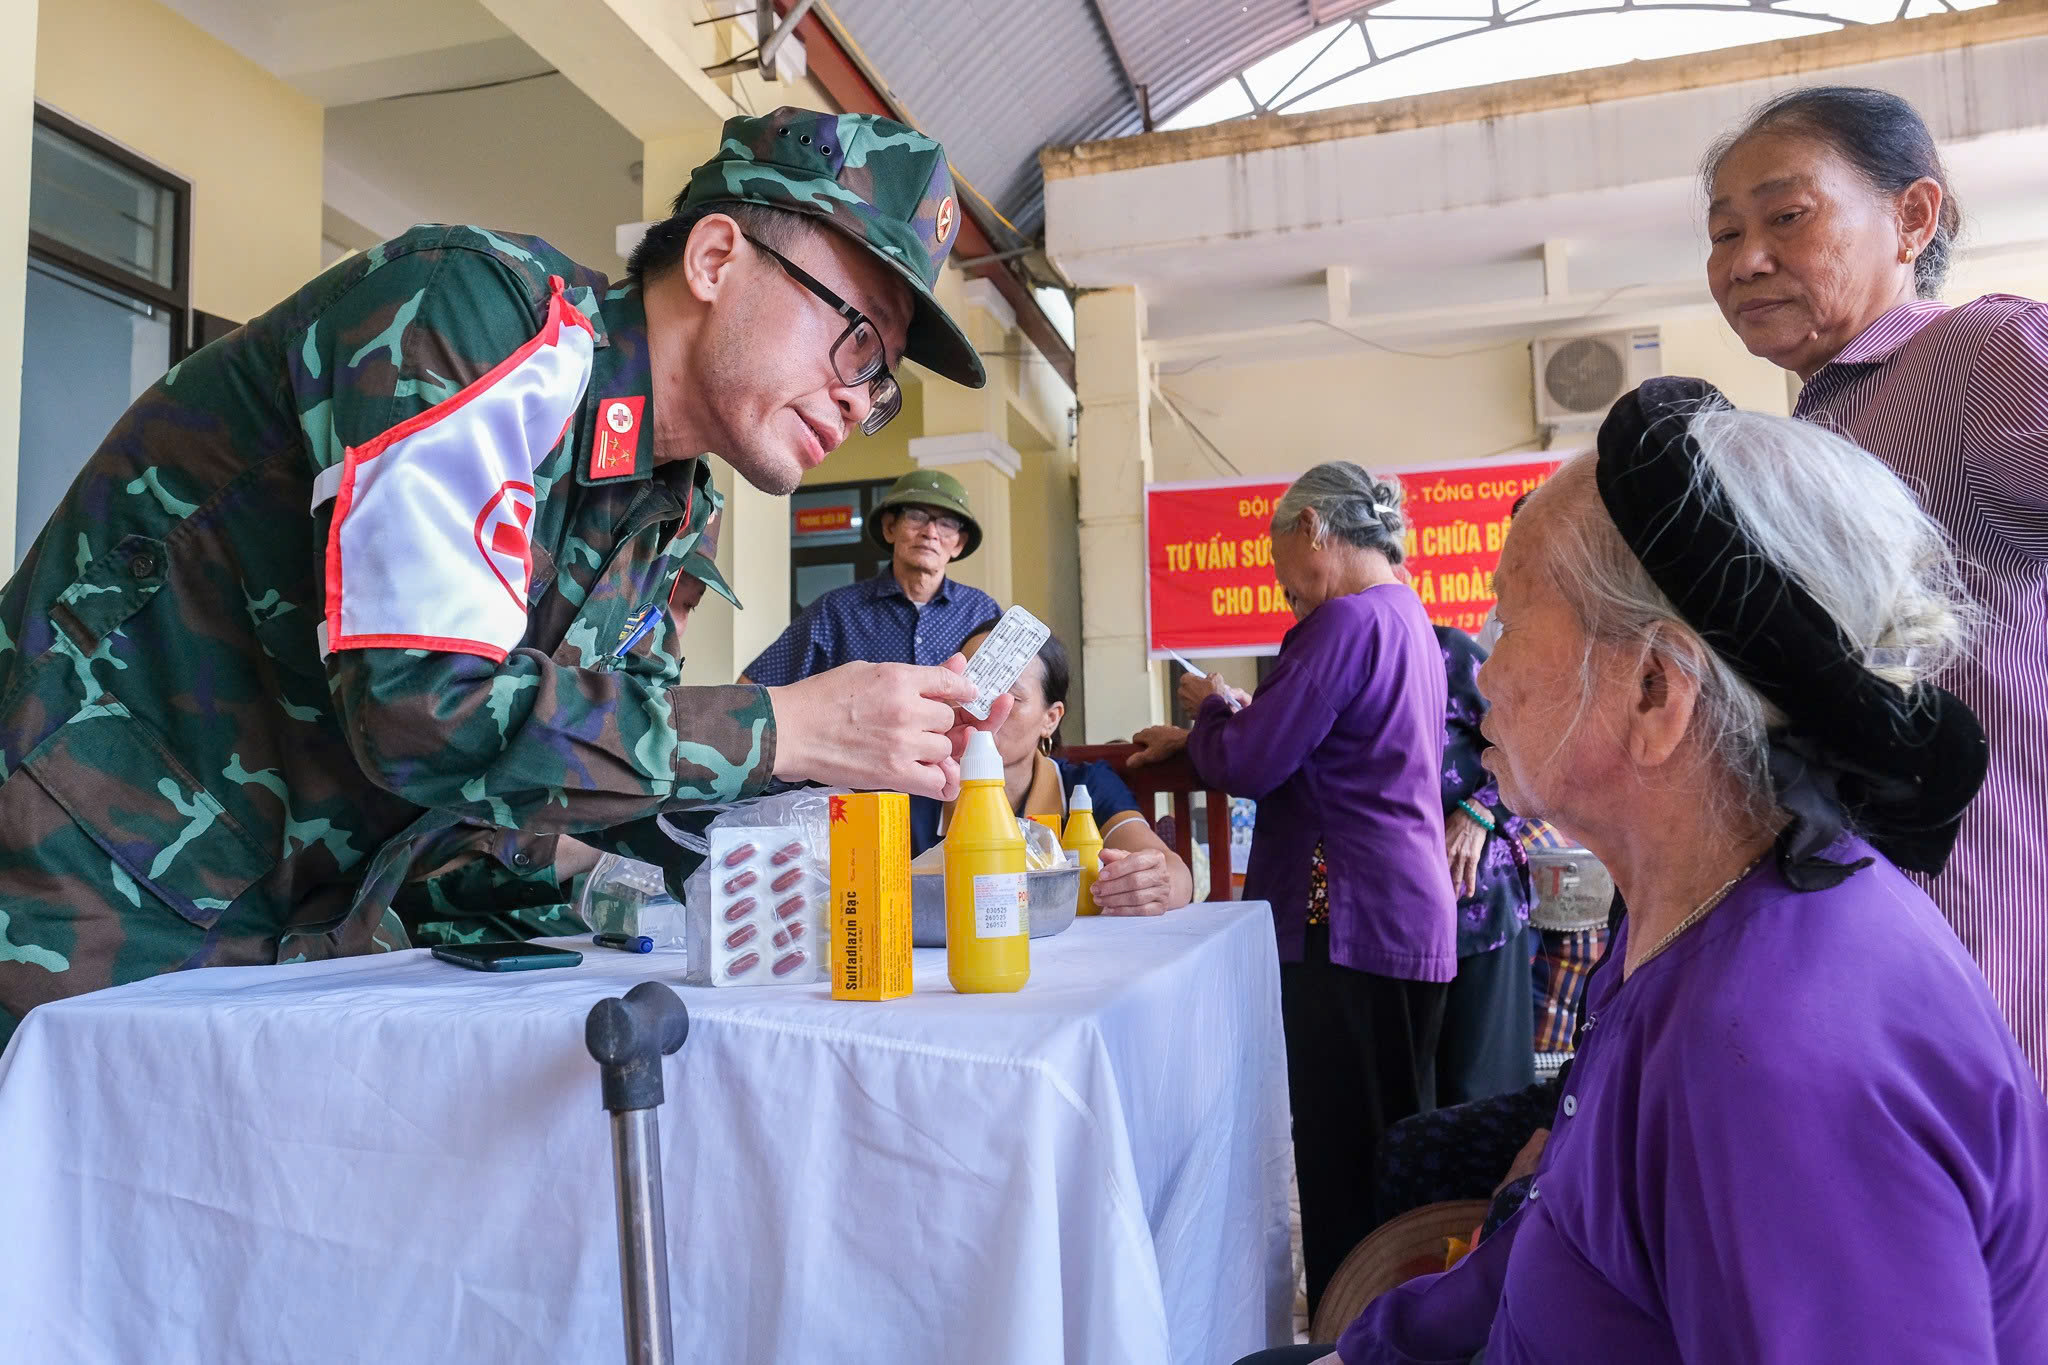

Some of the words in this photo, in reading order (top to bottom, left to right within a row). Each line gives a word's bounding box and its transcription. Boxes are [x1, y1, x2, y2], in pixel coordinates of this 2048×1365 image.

[1239, 495, 1269, 519] ĐỘI
[1421, 478, 1474, 503] TỔNG
[1478, 480, 1518, 501] CỤC
[1166, 540, 1192, 572] TƯ
[1195, 532, 1236, 571] VẤN
[1422, 519, 1481, 556] CHỮA
[1212, 585, 1253, 616] CHO
[1457, 612, 1474, 629] 13
[845, 891, 859, 915] Bạc
[845, 920, 857, 990] Sulfadiazin
